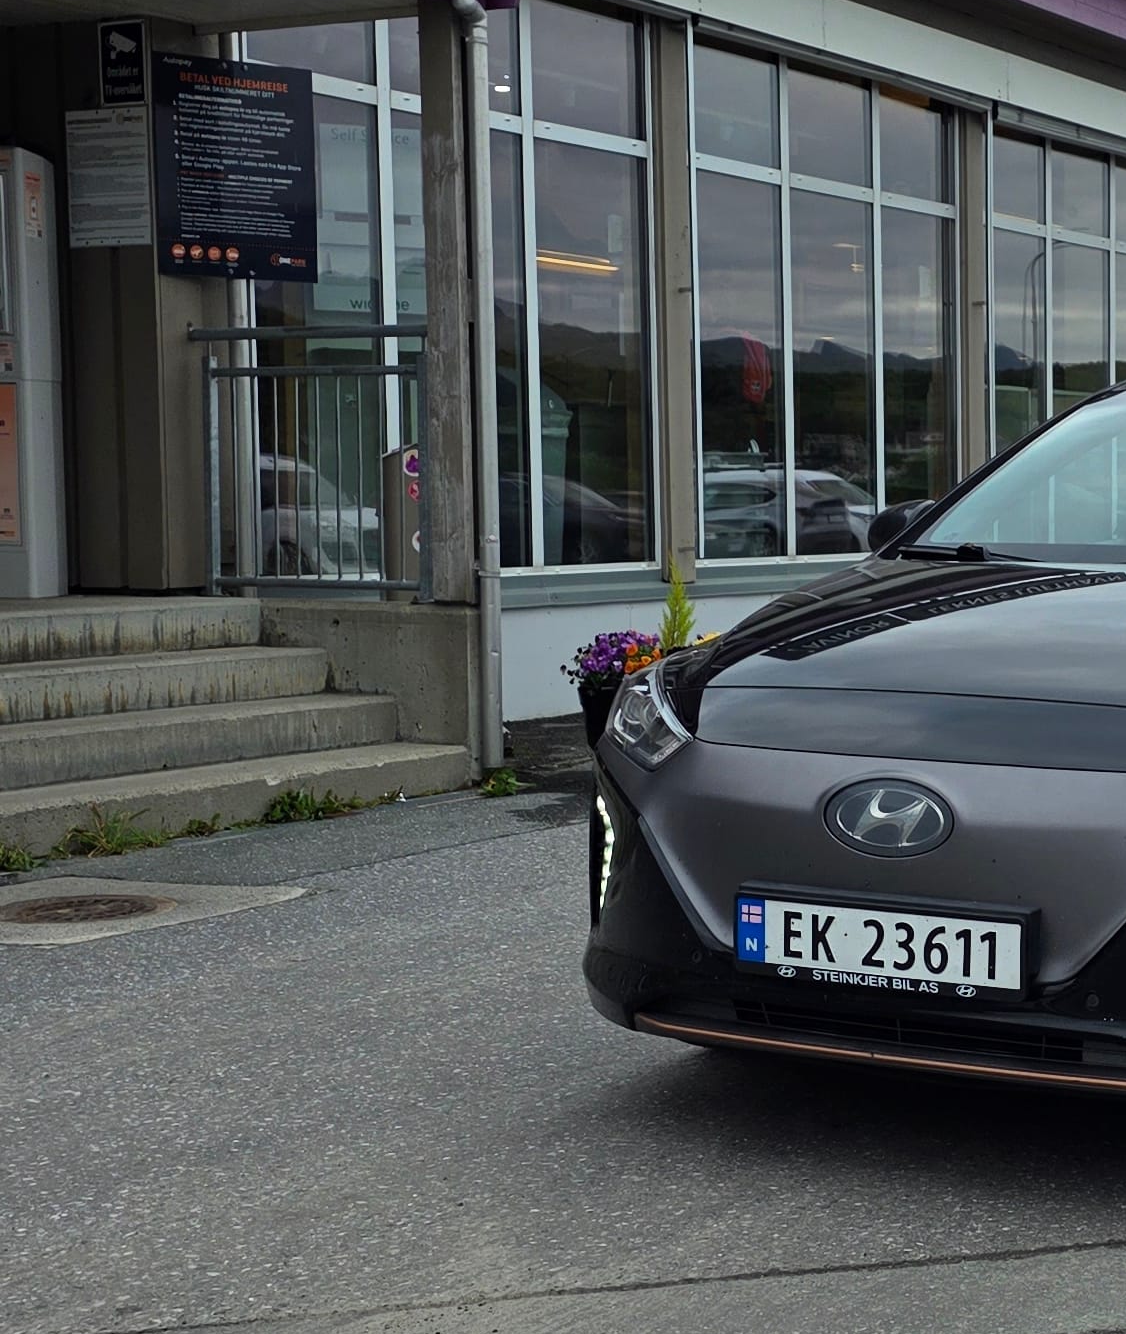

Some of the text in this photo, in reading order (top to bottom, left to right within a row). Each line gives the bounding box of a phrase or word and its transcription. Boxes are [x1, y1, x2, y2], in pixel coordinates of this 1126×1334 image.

[179, 71, 289, 93] BETAL VED HJEMREISE
[745, 937, 758, 952] N
[783, 910, 998, 981] EK 23611
[811, 969, 940, 994] STEINKJER BIL AS
